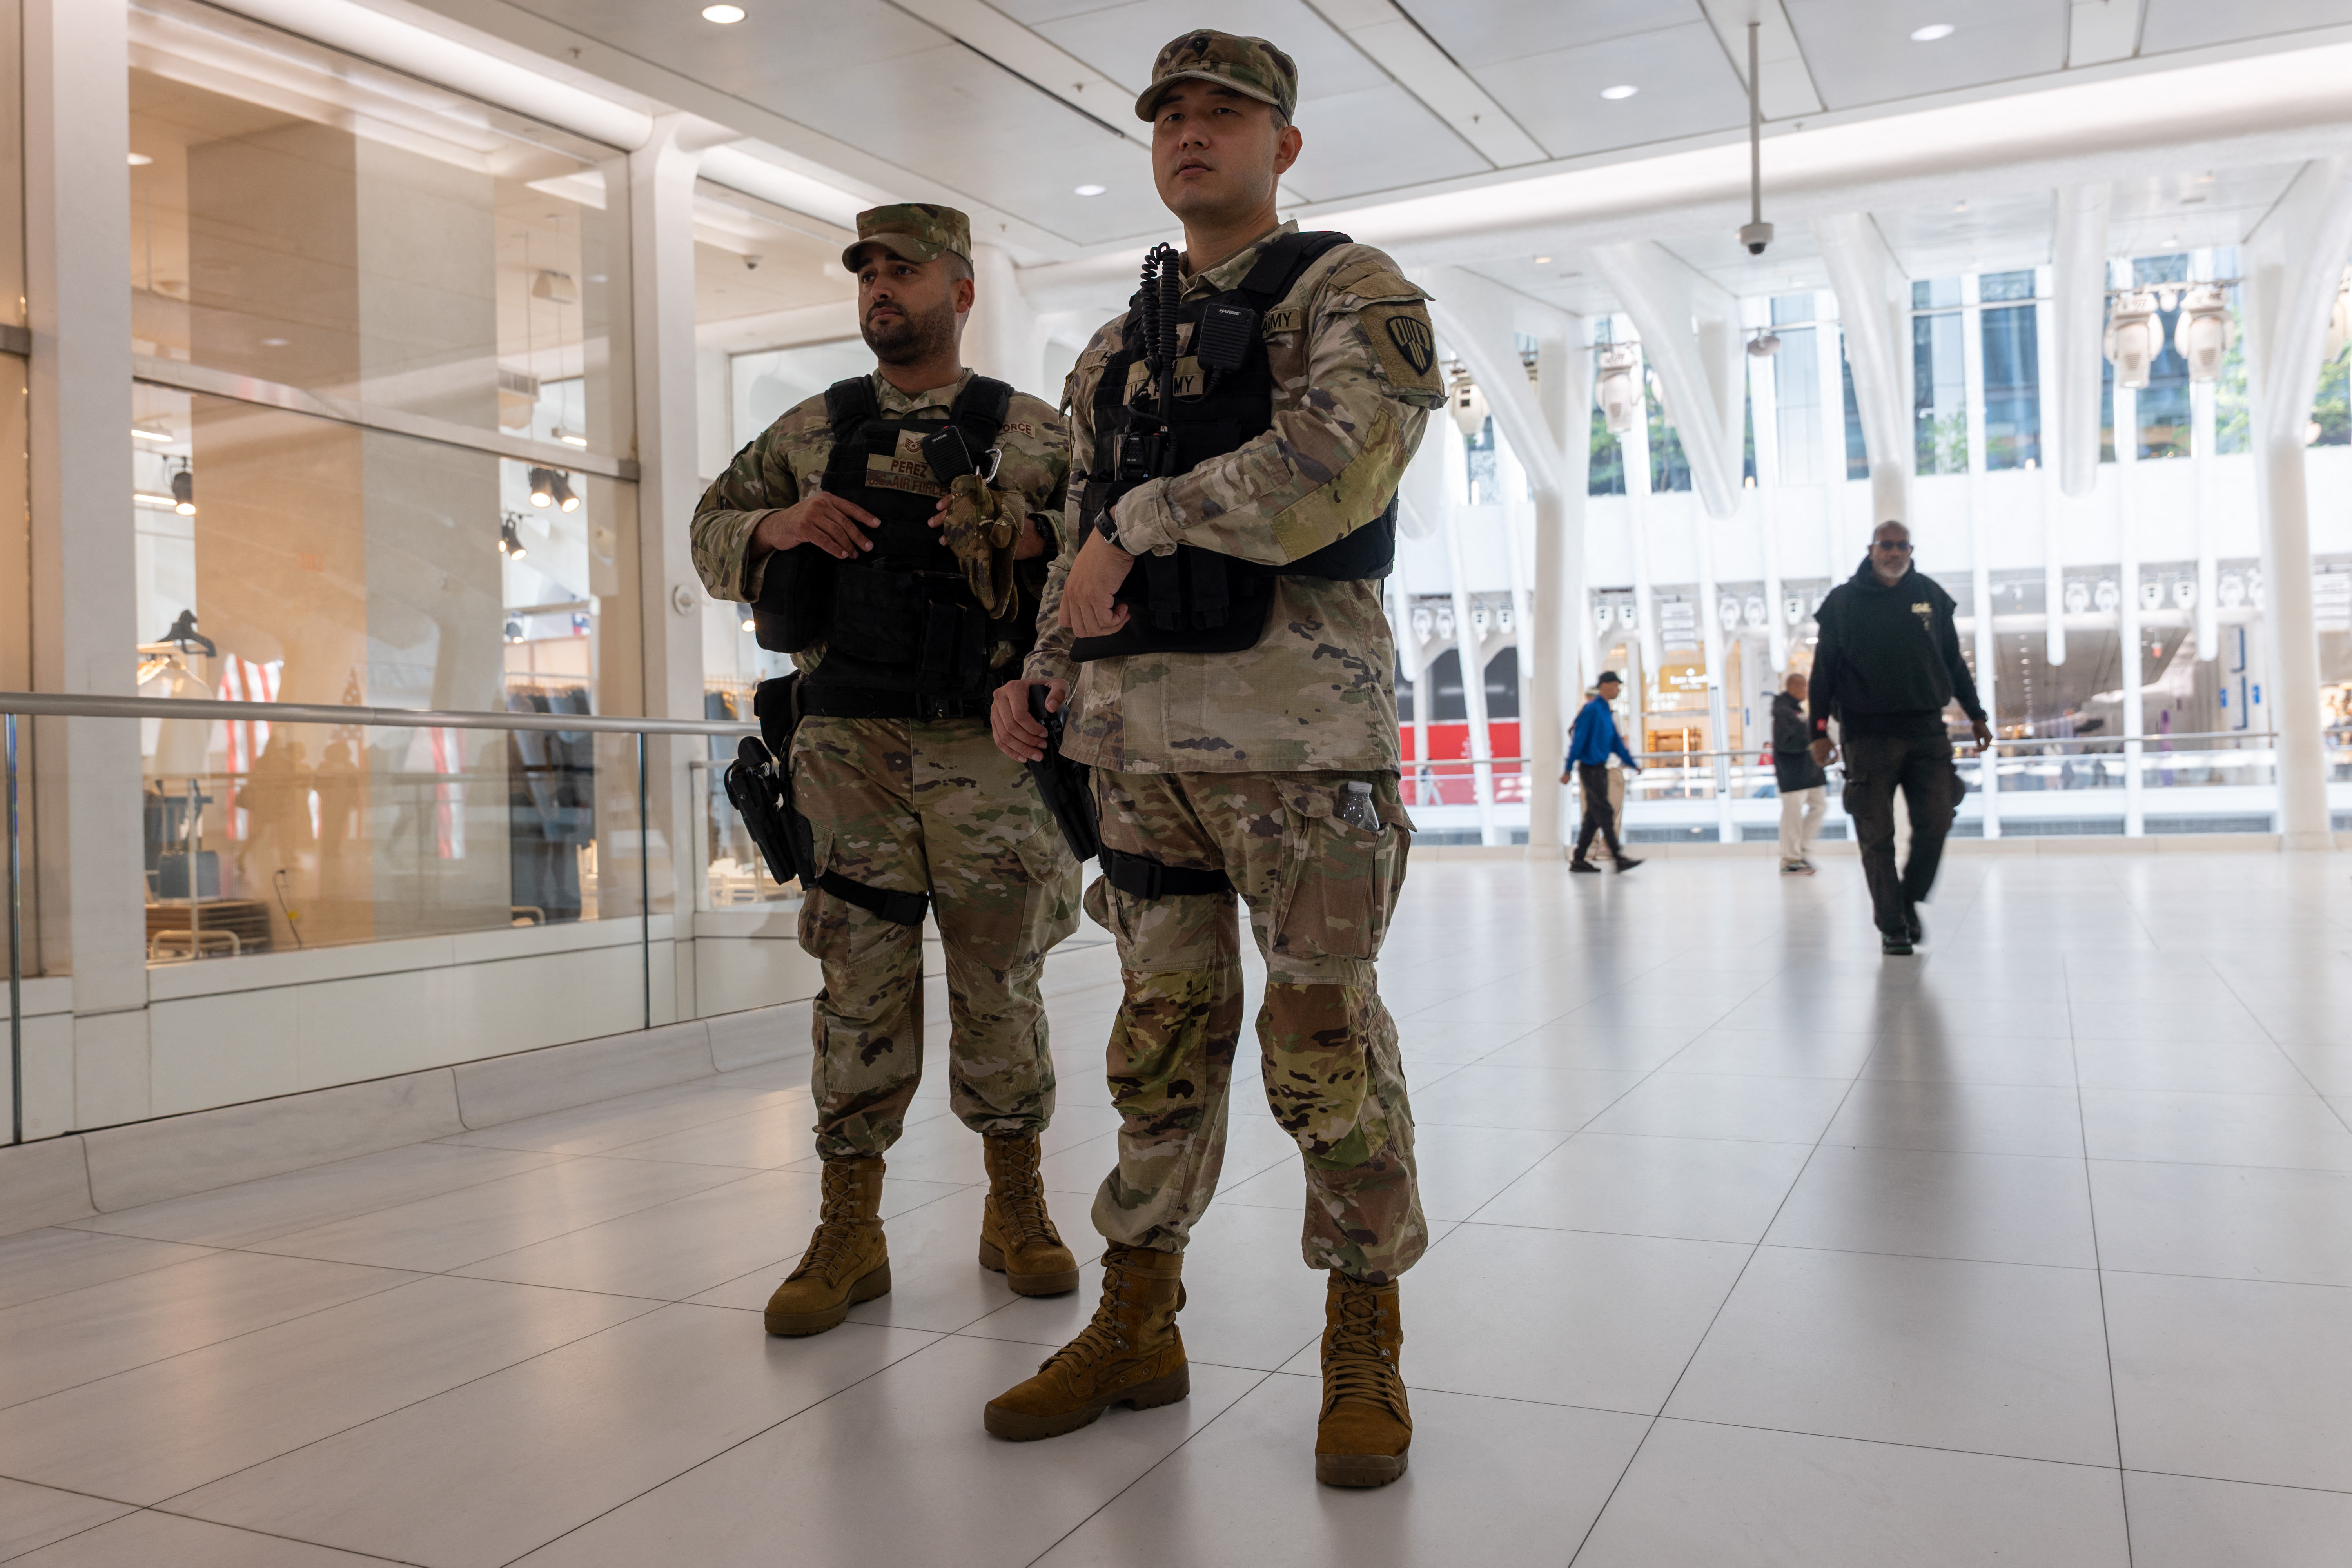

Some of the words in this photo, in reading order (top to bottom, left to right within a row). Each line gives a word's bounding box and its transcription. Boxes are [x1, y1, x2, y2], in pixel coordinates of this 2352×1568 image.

[1261, 312, 1292, 332] ARMY
[1003, 423, 1031, 435] ORCE
[932, 434, 947, 443] HARRIS
[891, 459, 928, 478] PEREZ
[868, 472, 888, 486] U.S.
[891, 475, 910, 490] AIR
